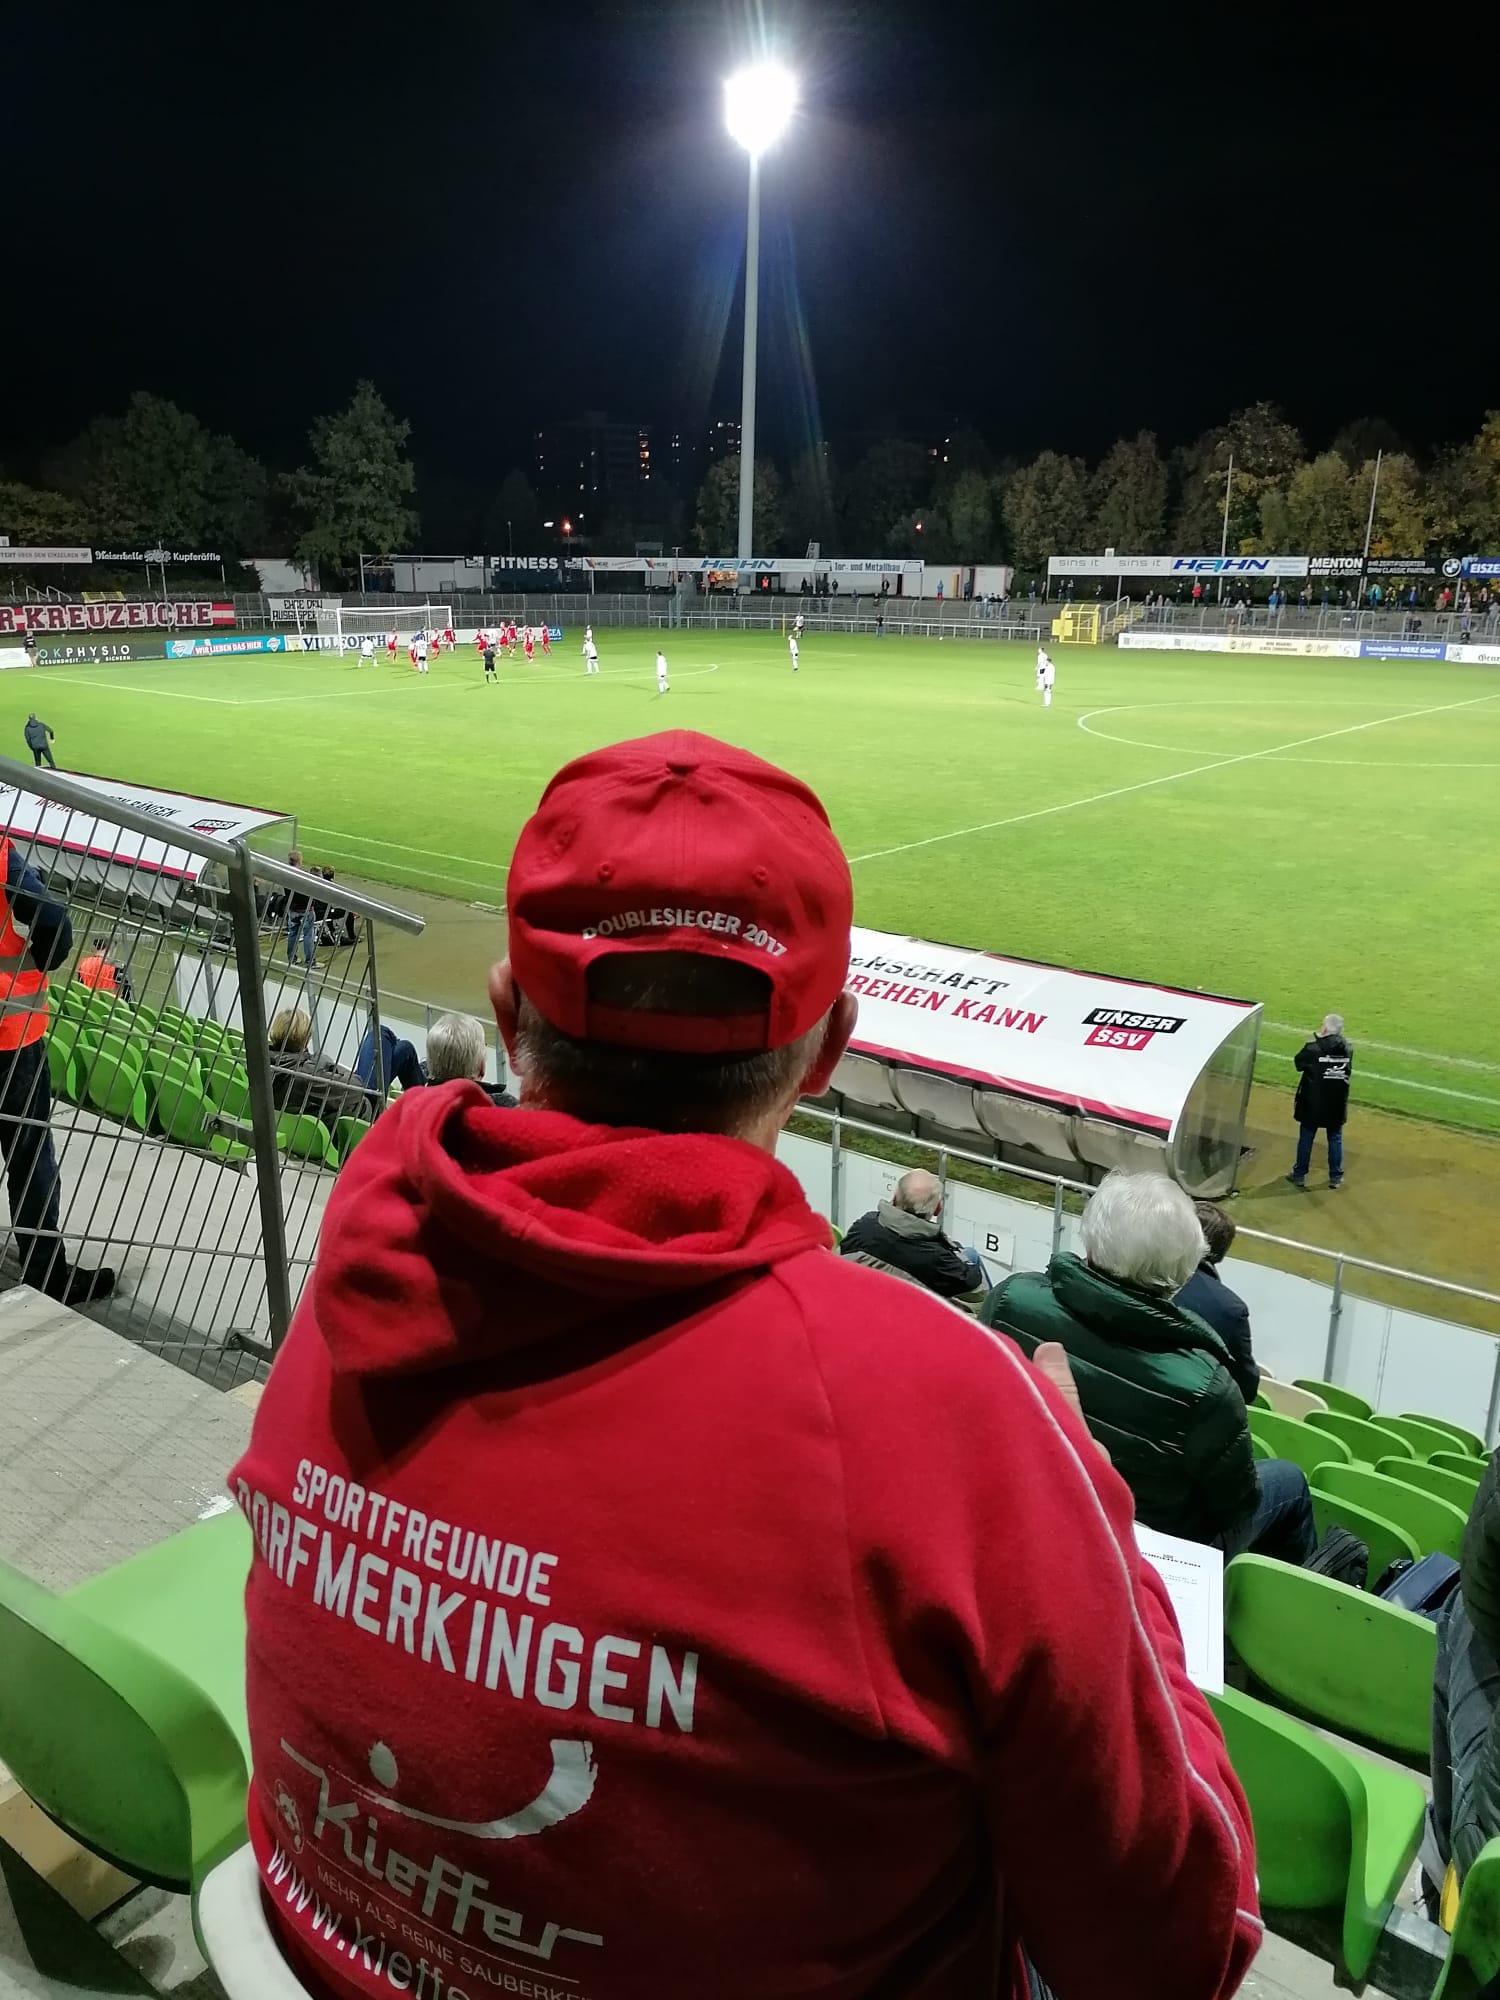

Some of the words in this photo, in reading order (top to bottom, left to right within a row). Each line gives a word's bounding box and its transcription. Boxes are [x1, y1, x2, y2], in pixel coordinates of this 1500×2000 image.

[490, 556, 558, 569] FITNESS
[850, 562, 863, 571] und
[865, 562, 901, 572] Metallbau
[23, 602, 213, 631] KREUZEICHE
[66, 644, 130, 658] PHYSIO
[581, 908, 742, 940] DOUBLESIEGER
[742, 923, 788, 957] 2017
[849, 973, 950, 1011] REHEN
[950, 998, 1049, 1034] KANN
[1092, 1010, 1177, 1031] UNSER
[1093, 1028, 1146, 1047] SSV
[985, 1232, 1000, 1253] B
[292, 1458, 559, 1607] SPORTFREUNDE
[317, 1864, 361, 1909] MEHR
[365, 1901, 398, 1930] ALS
[401, 1923, 455, 1966] REINE
